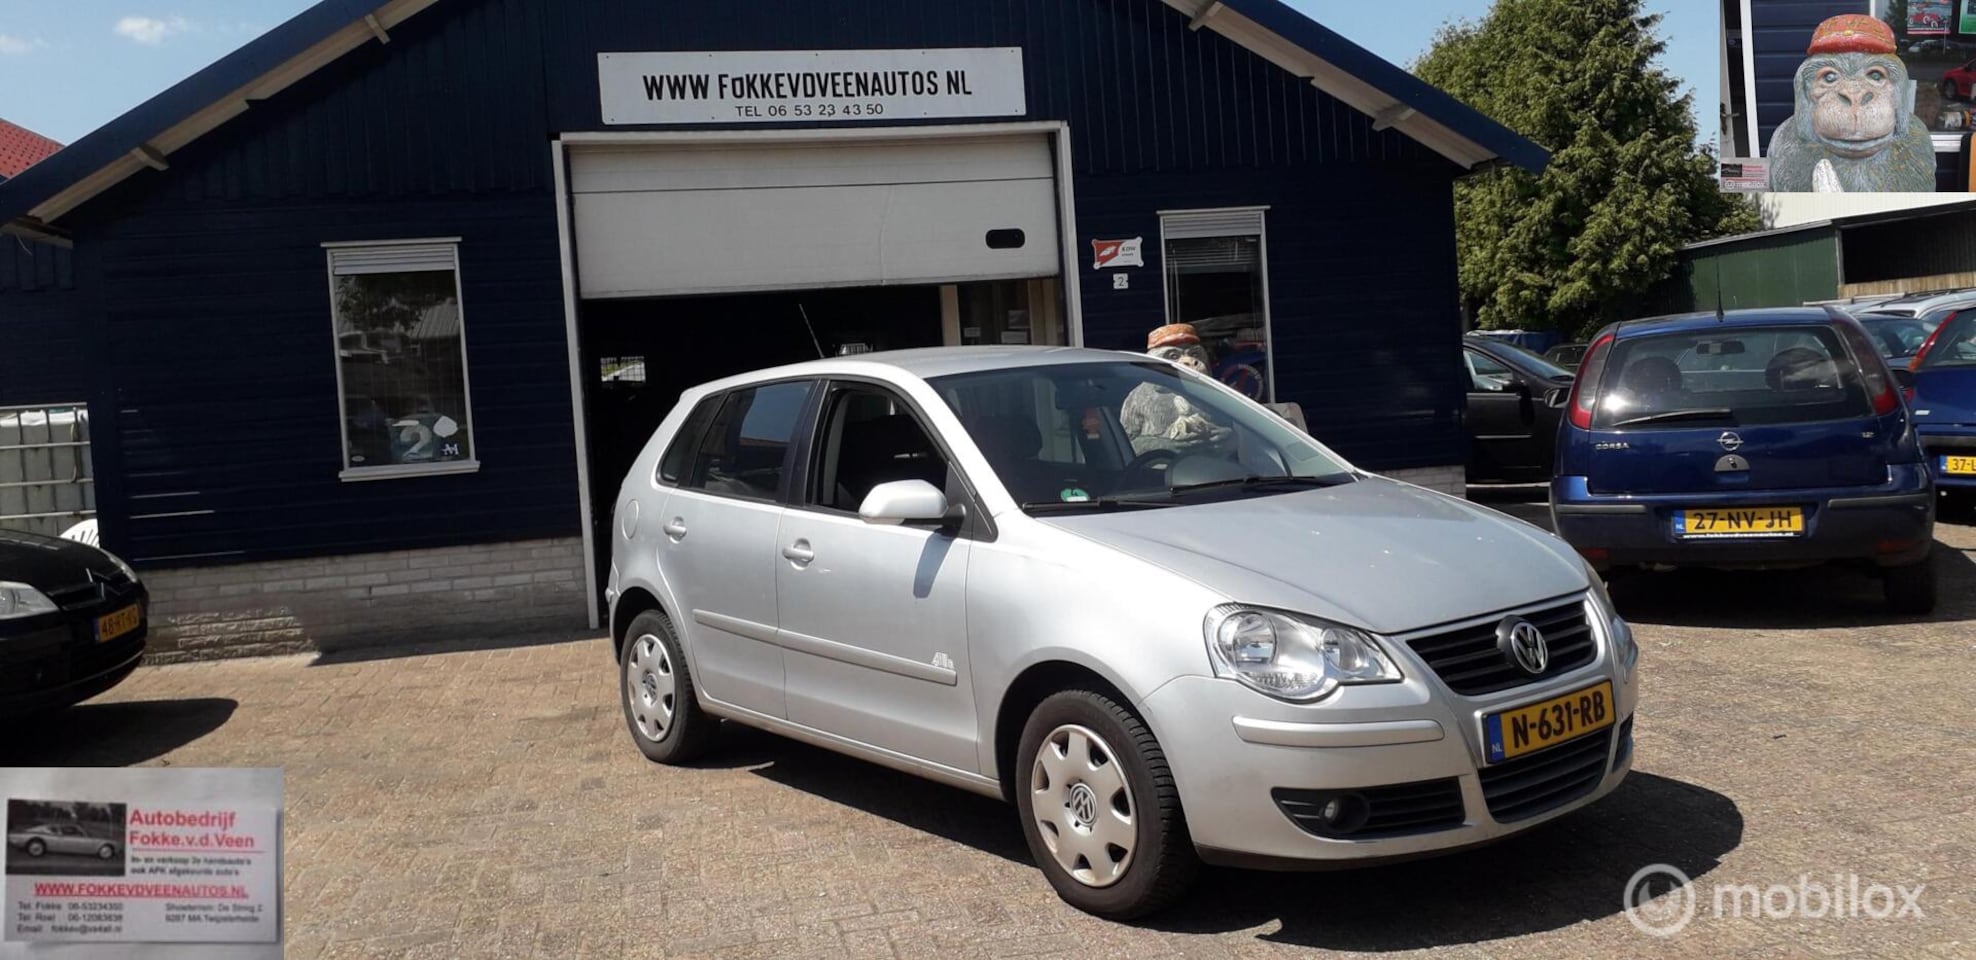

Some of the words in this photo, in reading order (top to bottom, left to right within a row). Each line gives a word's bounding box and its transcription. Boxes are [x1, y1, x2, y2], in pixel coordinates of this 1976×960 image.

[643, 74, 709, 101] WWW
[946, 70, 972, 95] NL
[736, 105, 762, 117] TEL
[768, 105, 787, 117] 06
[794, 105, 812, 116] 53
[818, 104, 836, 117] 23
[842, 104, 861, 116] 43
[866, 103, 884, 115] 50
[1595, 442, 1630, 450] CORSA
[1693, 510, 1793, 530] 27-NV-JH
[1511, 690, 1606, 749] N-631-RB
